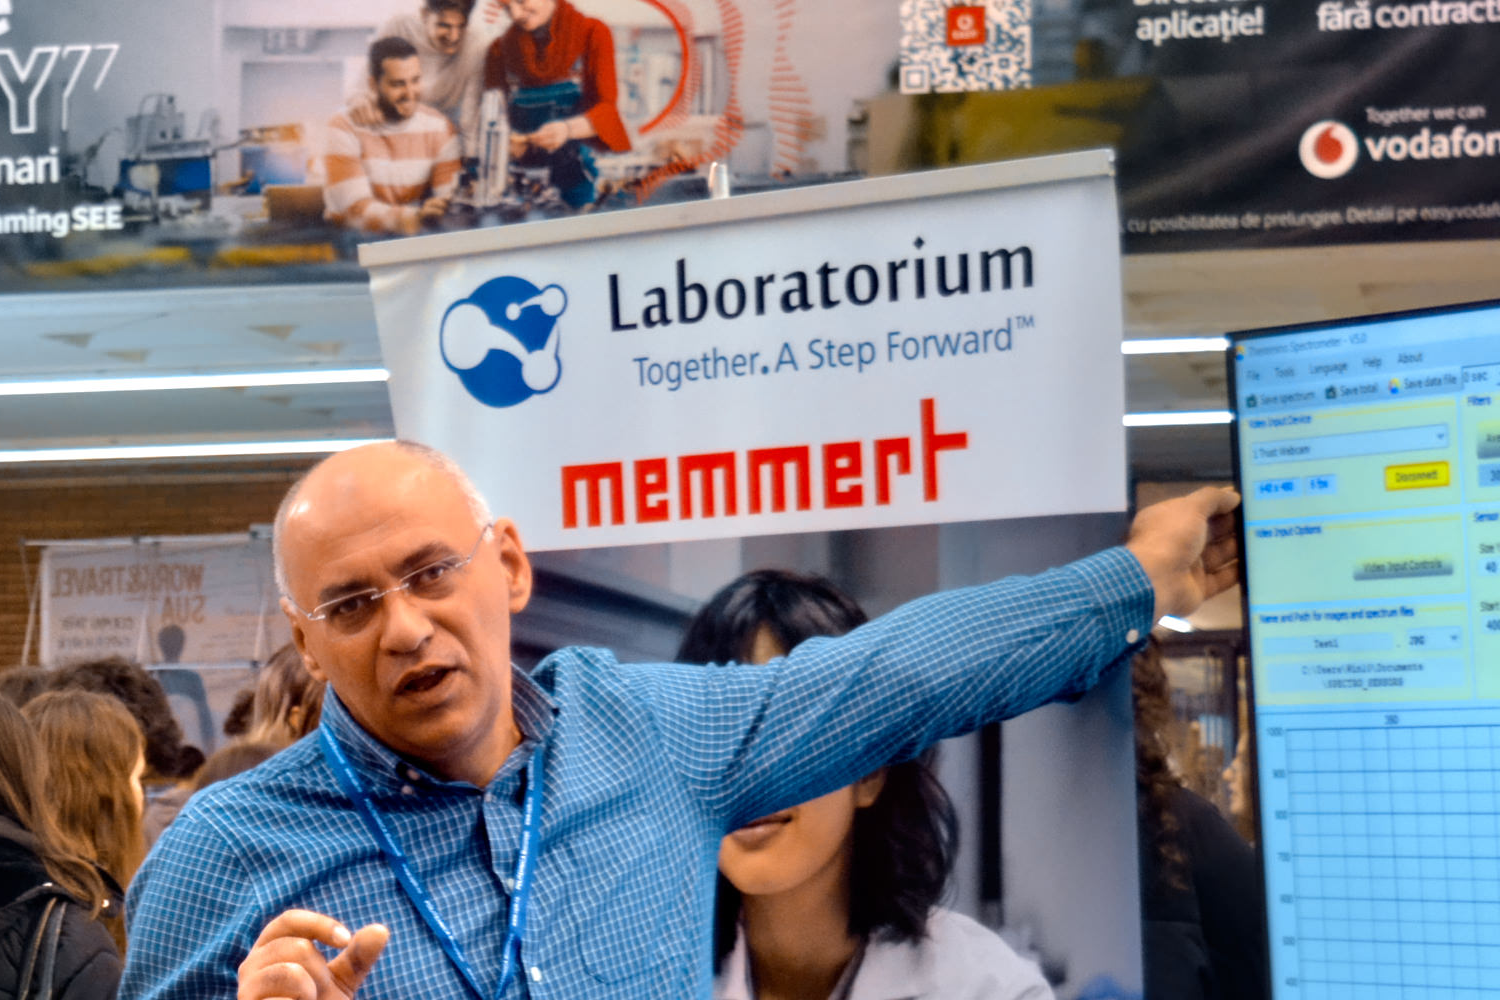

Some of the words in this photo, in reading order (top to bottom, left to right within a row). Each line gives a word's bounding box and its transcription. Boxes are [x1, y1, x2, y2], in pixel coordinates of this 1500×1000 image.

[1136, 6, 1265, 47] aplicație!
[1317, 3, 1370, 31] fără
[1374, 0, 1500, 29] contract
[1366, 106, 1430, 127] Together
[1432, 107, 1456, 120] we
[1457, 105, 1486, 120] can
[71, 203, 123, 231] SEE
[608, 236, 1036, 332] Laboratorium
[633, 345, 771, 392] Together.
[775, 342, 800, 373] A
[807, 336, 877, 375] Step
[560, 397, 969, 530] memmert
